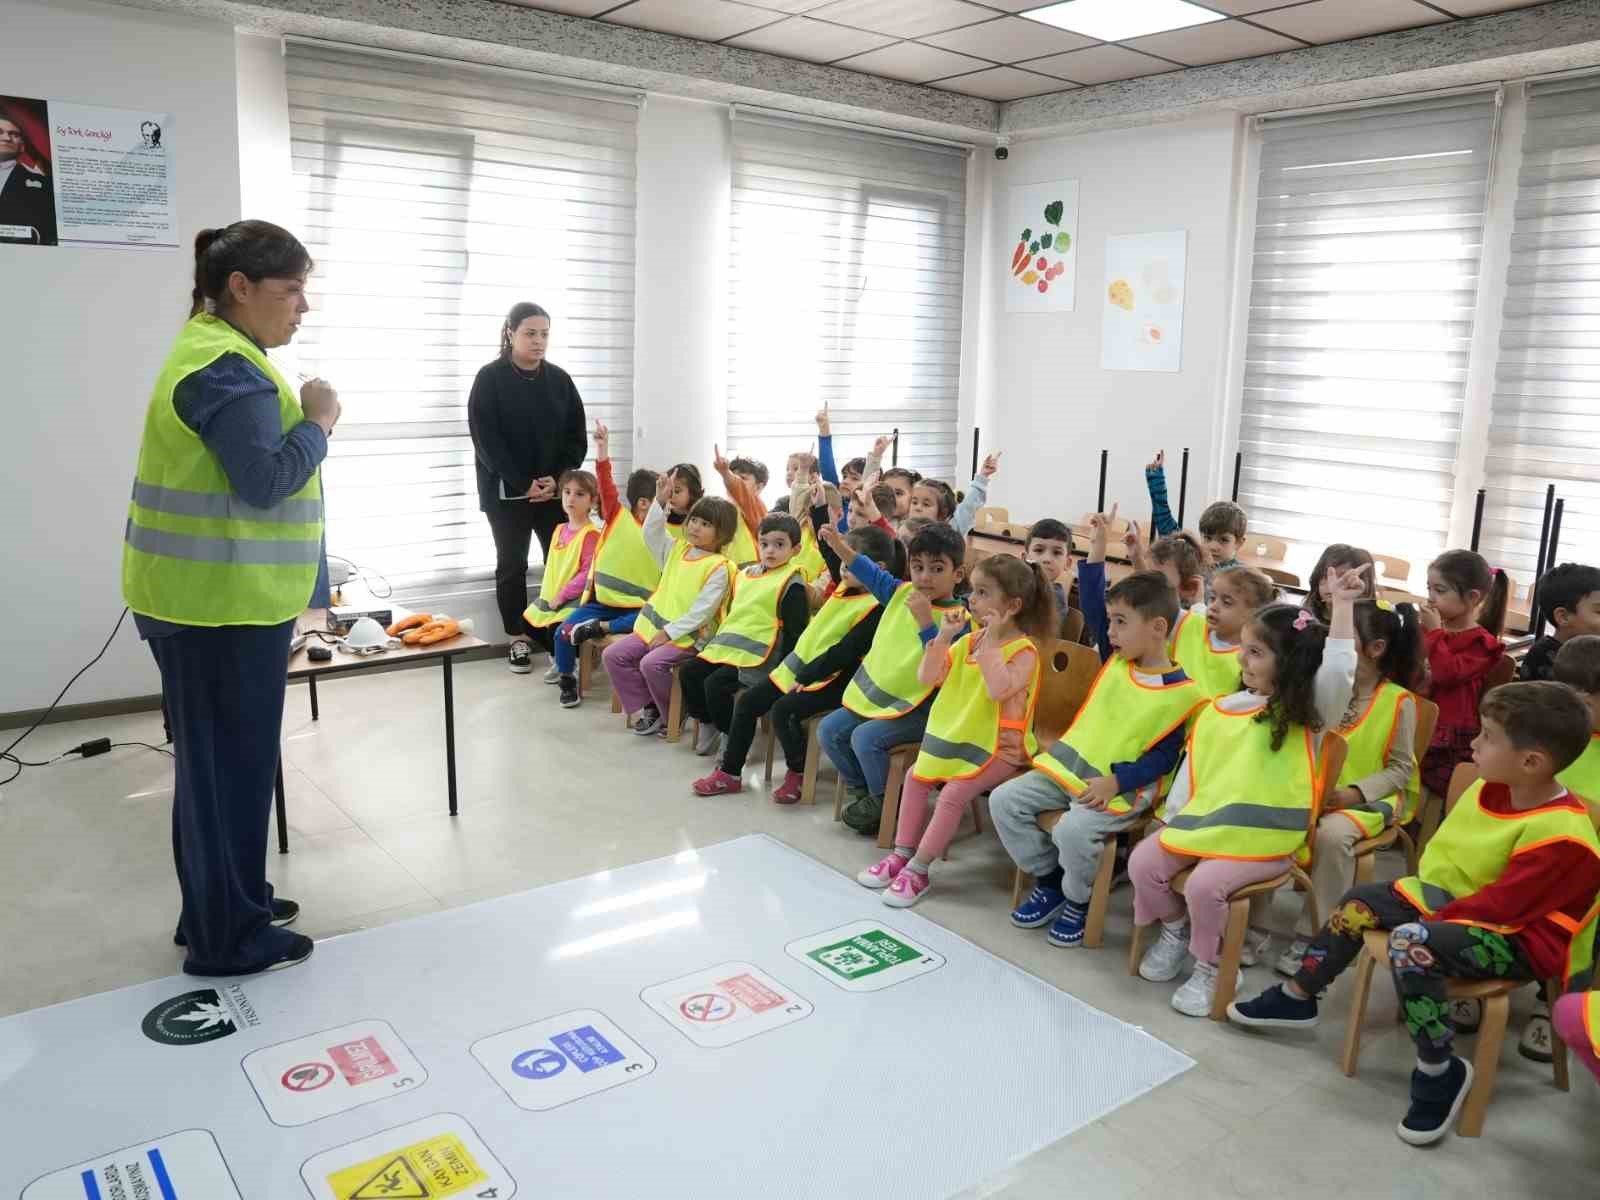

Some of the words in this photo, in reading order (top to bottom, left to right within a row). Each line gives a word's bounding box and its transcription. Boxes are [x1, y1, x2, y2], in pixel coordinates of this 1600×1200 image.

[921, 957, 935, 965] 1
[786, 1004, 802, 1014] 2
[625, 1063, 643, 1073] 3
[392, 1077, 415, 1088] 5
[418, 1149, 453, 1188] KAYGAN
[477, 1187, 498, 1198] 4
